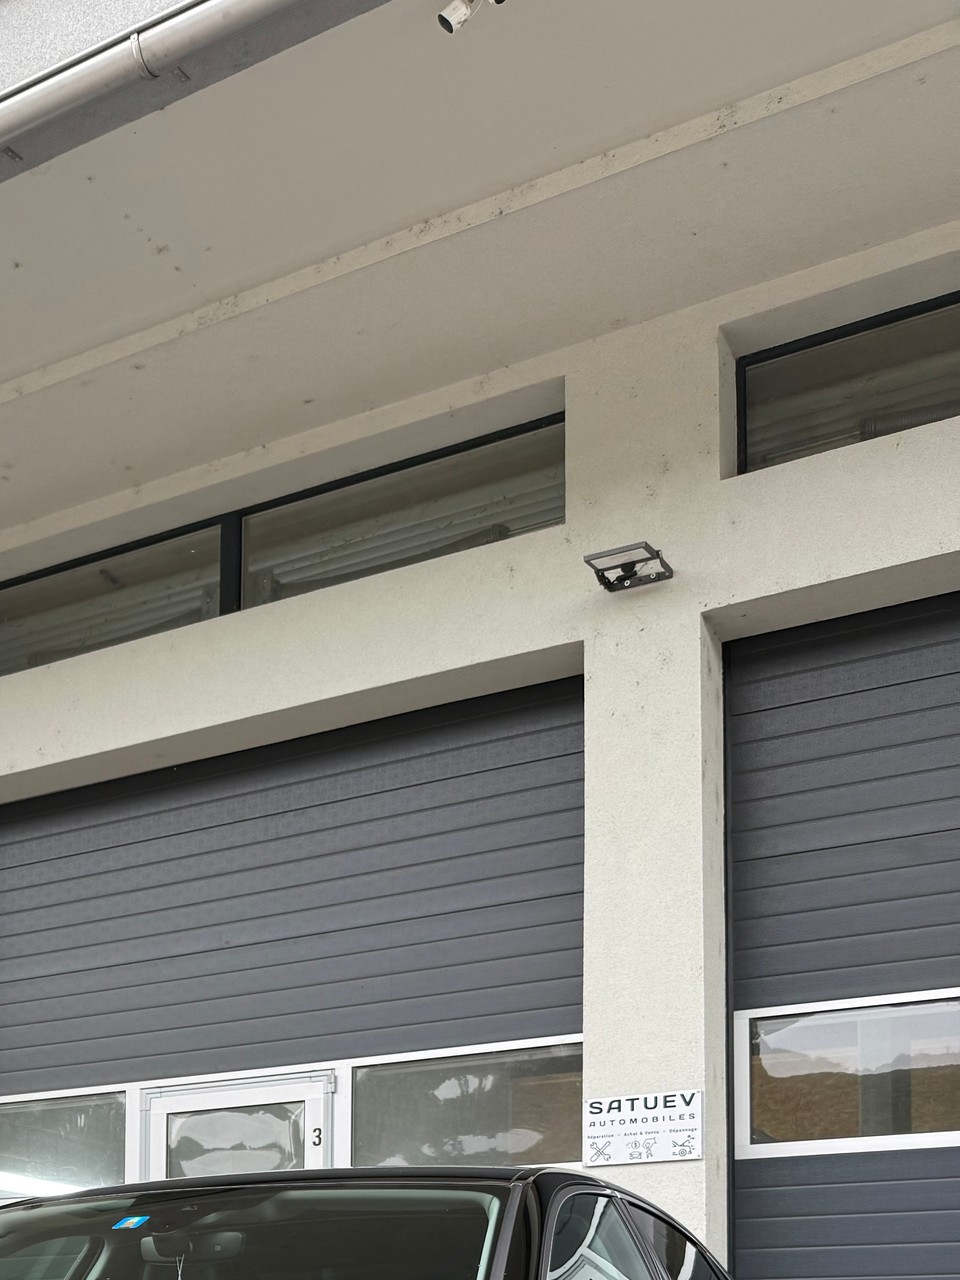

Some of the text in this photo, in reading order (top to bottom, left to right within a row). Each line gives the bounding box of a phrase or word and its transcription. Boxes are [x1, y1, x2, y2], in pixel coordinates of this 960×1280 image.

[589, 1092, 696, 1115] SATUEV
[589, 1113, 695, 1128] AUTOMOBILES
[312, 1127, 322, 1147] 3
